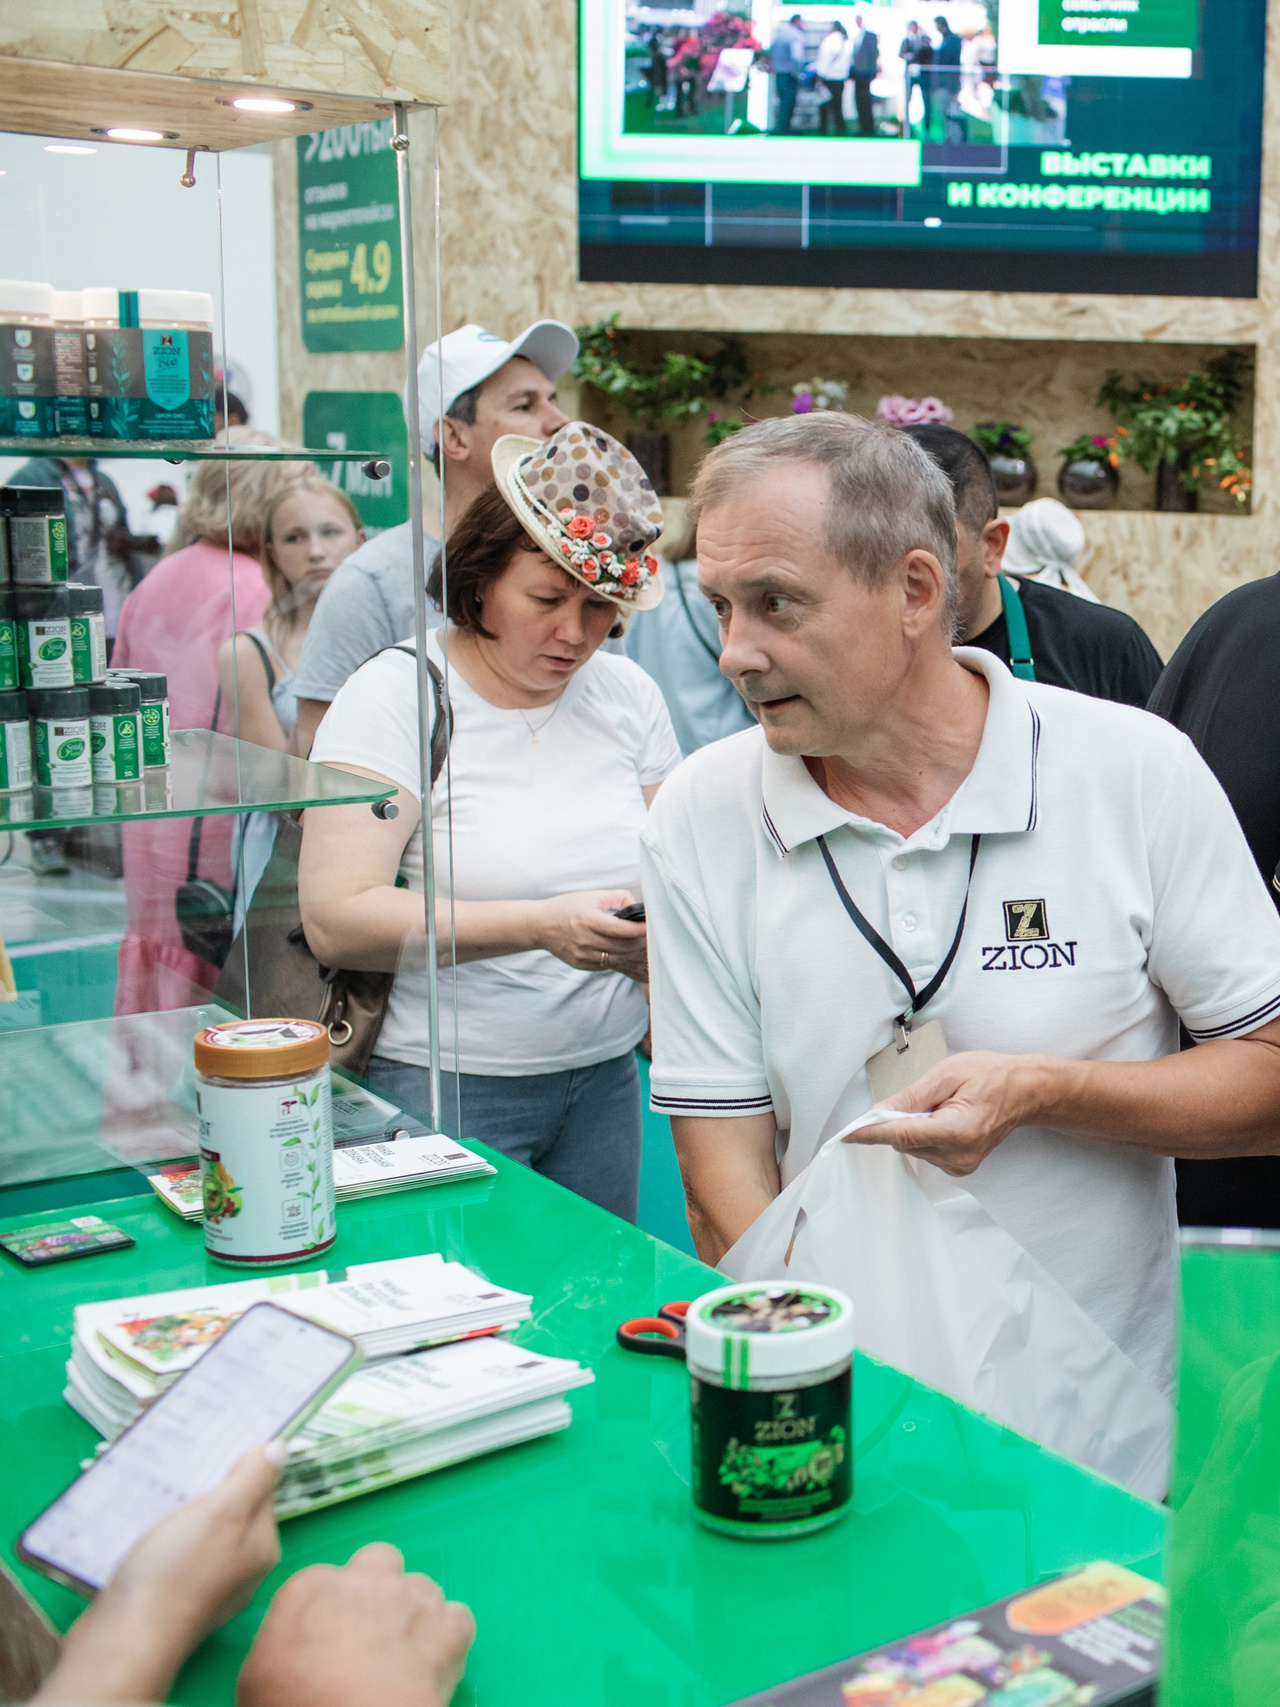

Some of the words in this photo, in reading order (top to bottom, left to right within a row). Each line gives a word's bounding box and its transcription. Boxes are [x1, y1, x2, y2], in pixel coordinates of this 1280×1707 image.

[1060, 16, 1128, 35] отрасли
[1040, 151, 1211, 179] ВЫСТАВКИ
[947, 181, 973, 207] И
[976, 183, 1211, 215] КОНФЕРЕНЦИИ
[351, 240, 392, 294] 4.9
[153, 346, 180, 355] ZION
[63, 726, 85, 734] ZION
[982, 941, 1077, 971] ZION
[754, 1415, 817, 1440] ZION
